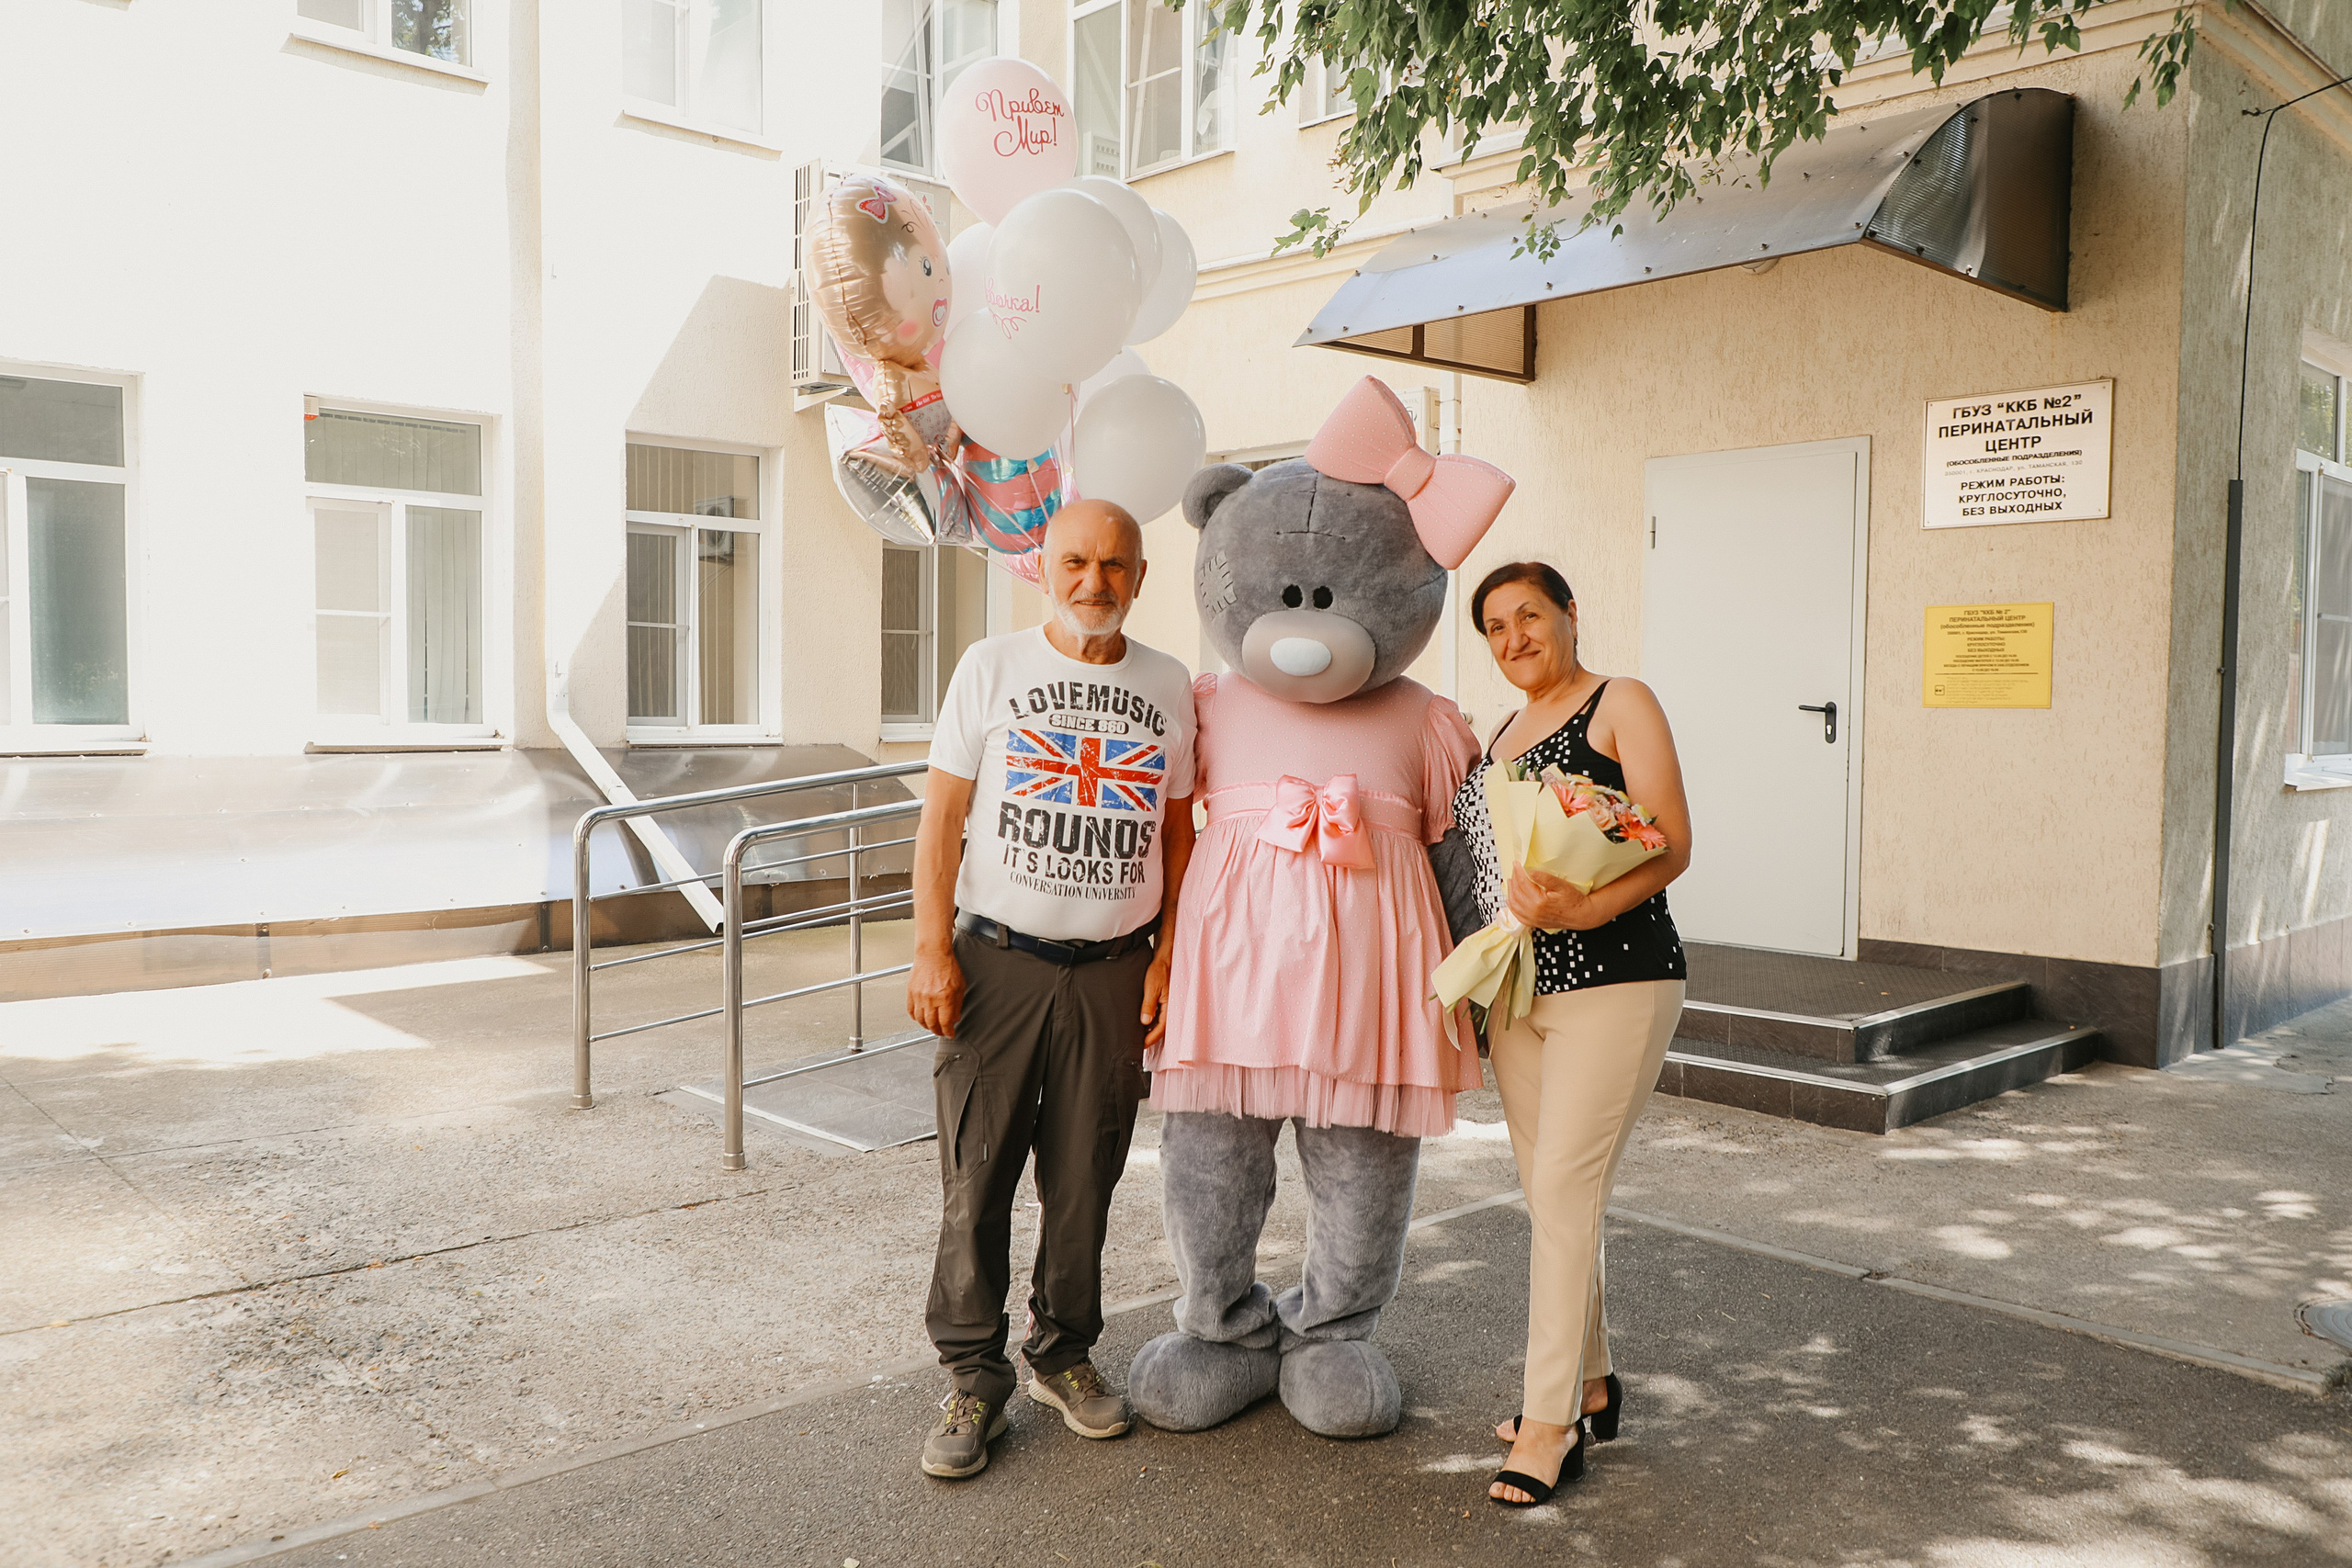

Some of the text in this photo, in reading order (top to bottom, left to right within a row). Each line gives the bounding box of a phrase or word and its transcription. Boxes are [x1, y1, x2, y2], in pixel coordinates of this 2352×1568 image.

[975, 87, 1065, 122] Привет
[993, 115, 1057, 157] Мир!
[1938, 408, 2094, 439] ПЕРИНАТАЛЬНЫЙ
[1952, 403, 1992, 419] ГБУЗ
[1984, 435, 2042, 454] ЦЕНТР
[1961, 474, 2065, 491] РЕЖИМ РАБОТЫ:
[1958, 488, 2067, 504] КРУГЛОСУТОЧНО,
[1962, 501, 2064, 516] БЕЗ ВЫХОДНЫХ
[1051, 714, 1125, 734] SINCE 860
[997, 800, 1157, 860] ROUNDS
[1045, 854, 1114, 886] LOOKS
[1119, 861, 1146, 885] FOR
[1010, 871, 1136, 901] CONVERSATION UNIVERSITY
